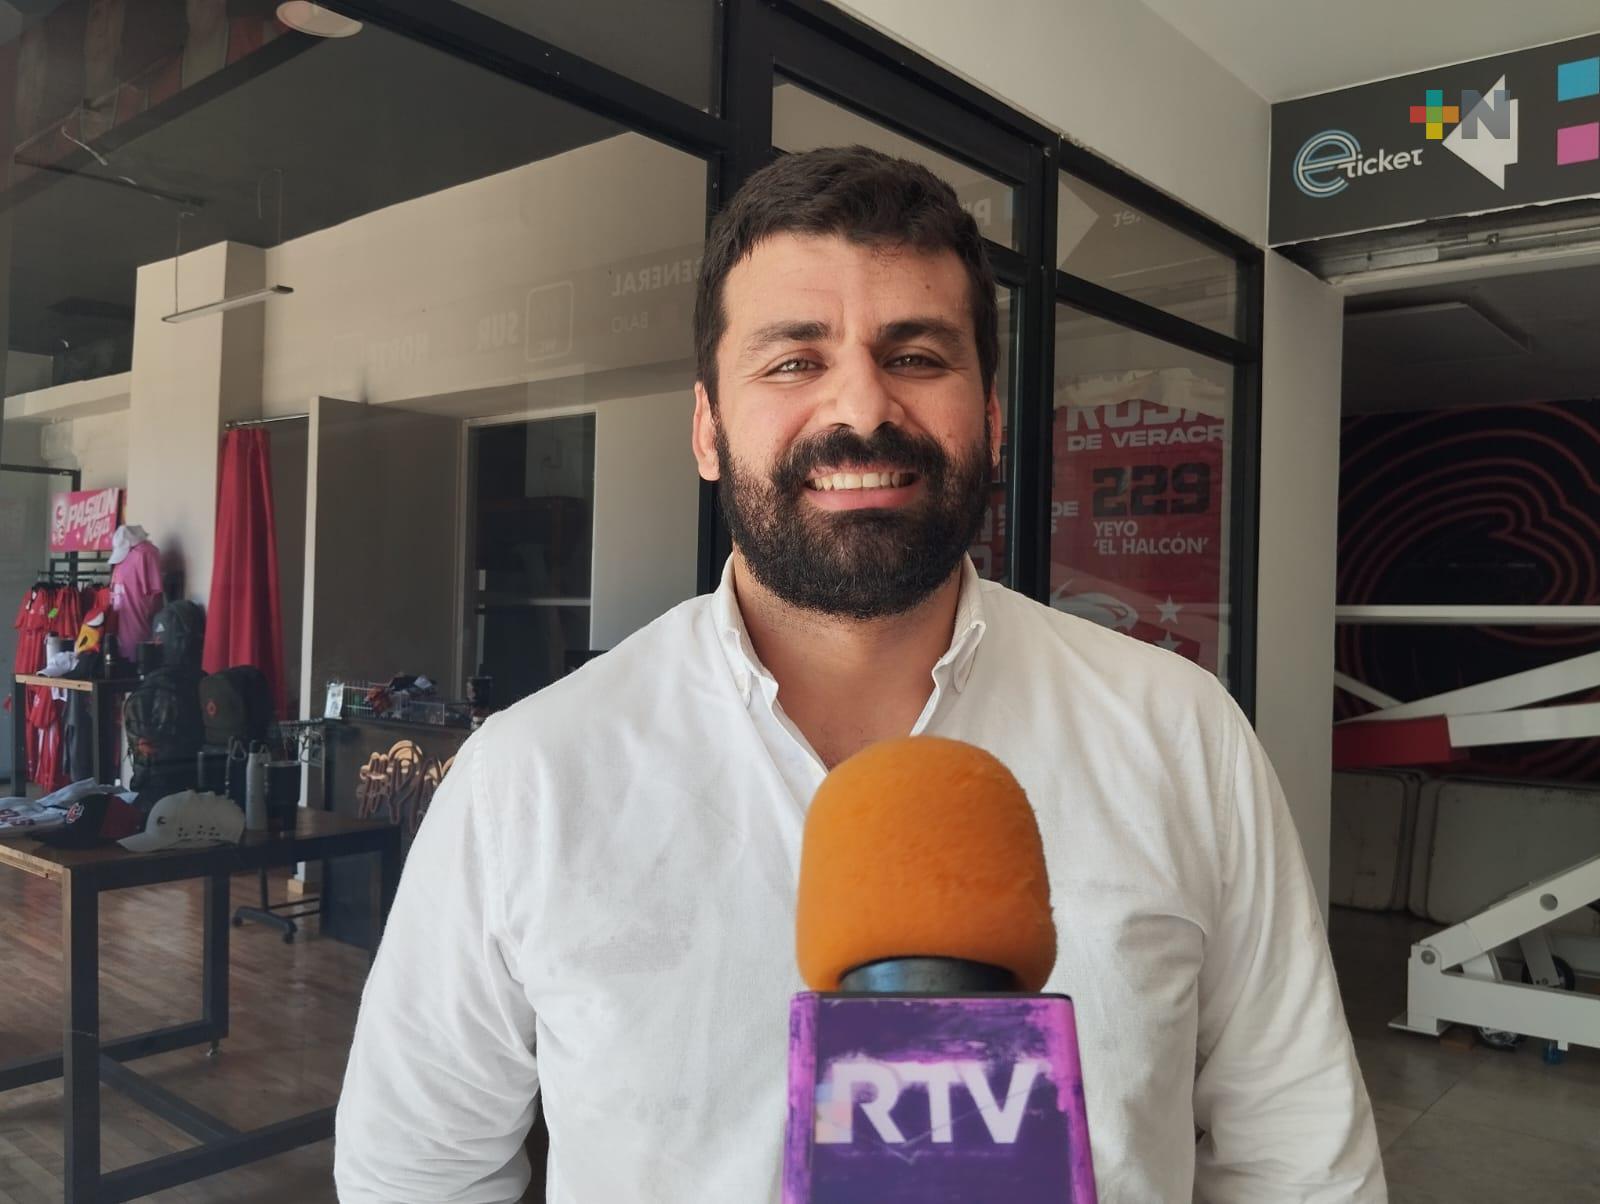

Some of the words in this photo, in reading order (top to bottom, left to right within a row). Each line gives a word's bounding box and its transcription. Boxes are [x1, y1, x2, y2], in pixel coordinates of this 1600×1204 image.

[1067, 434, 1102, 452] DE
[1091, 462, 1211, 518] 229
[1093, 521, 1138, 538] YEYO
[815, 1061, 1039, 1144] RTV
